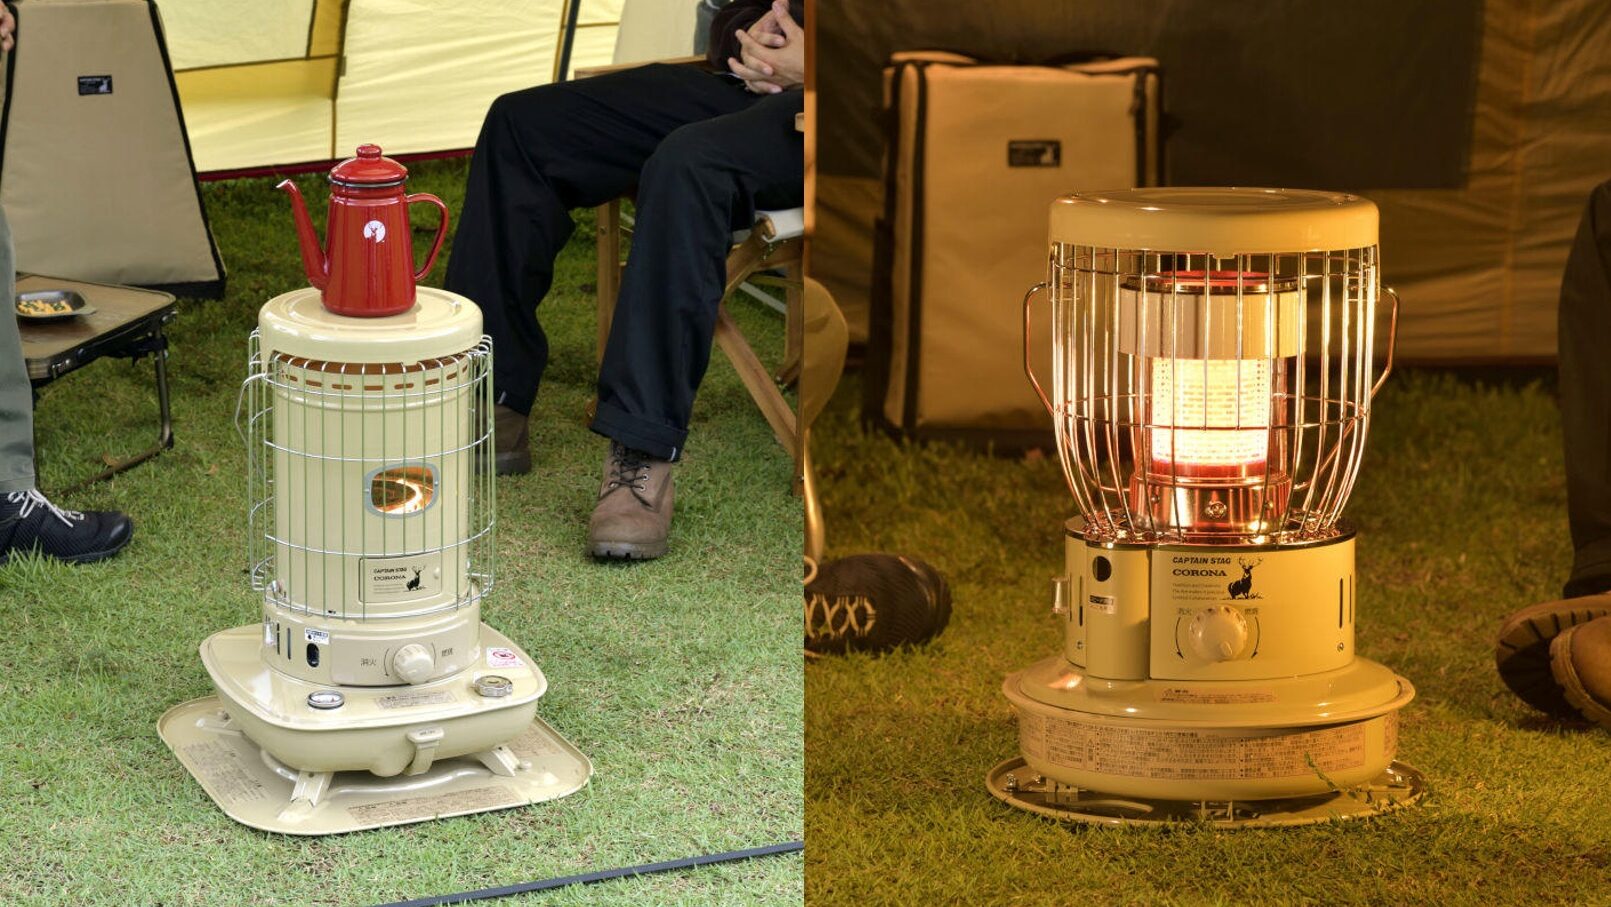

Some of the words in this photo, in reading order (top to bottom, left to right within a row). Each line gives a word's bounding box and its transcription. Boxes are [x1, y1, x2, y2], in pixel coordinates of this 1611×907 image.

[1172, 556, 1208, 564] CAPTAIN
[1210, 556, 1231, 565] STAG
[1172, 568, 1227, 577] CORONA
